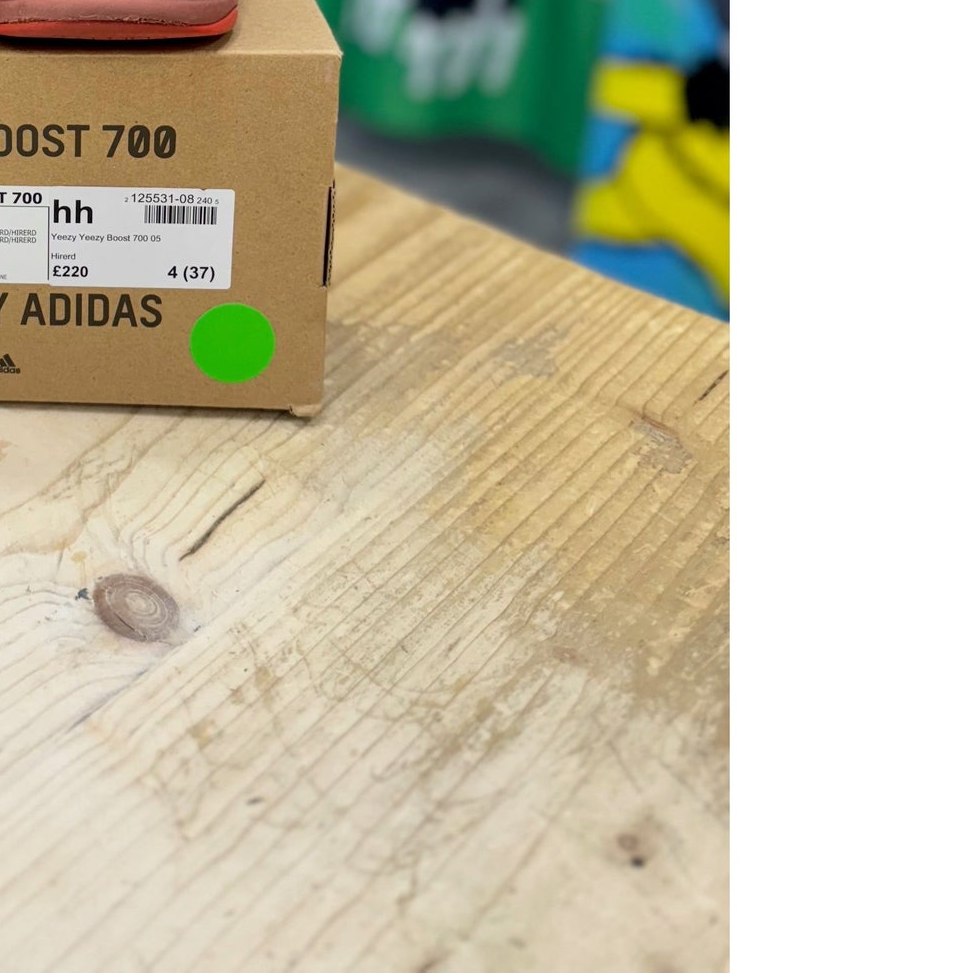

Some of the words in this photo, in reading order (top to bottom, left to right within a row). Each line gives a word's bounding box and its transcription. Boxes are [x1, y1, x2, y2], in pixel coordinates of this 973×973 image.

[102, 125, 177, 158] 700
[12, 192, 43, 204] 700
[132, 193, 195, 204] 125531-08
[53, 199, 93, 224] hh
[51, 233, 77, 242] Yeezy
[79, 233, 105, 242] Yeezy
[107, 234, 131, 242] Boost
[133, 234, 148, 242] 700
[150, 234, 162, 242] 05
[51, 252, 76, 260] Hirerd
[53, 266, 88, 277] £220
[167, 266, 177, 278] 4
[183, 266, 215, 282] (37)
[20, 293, 163, 328] ADIDAS
